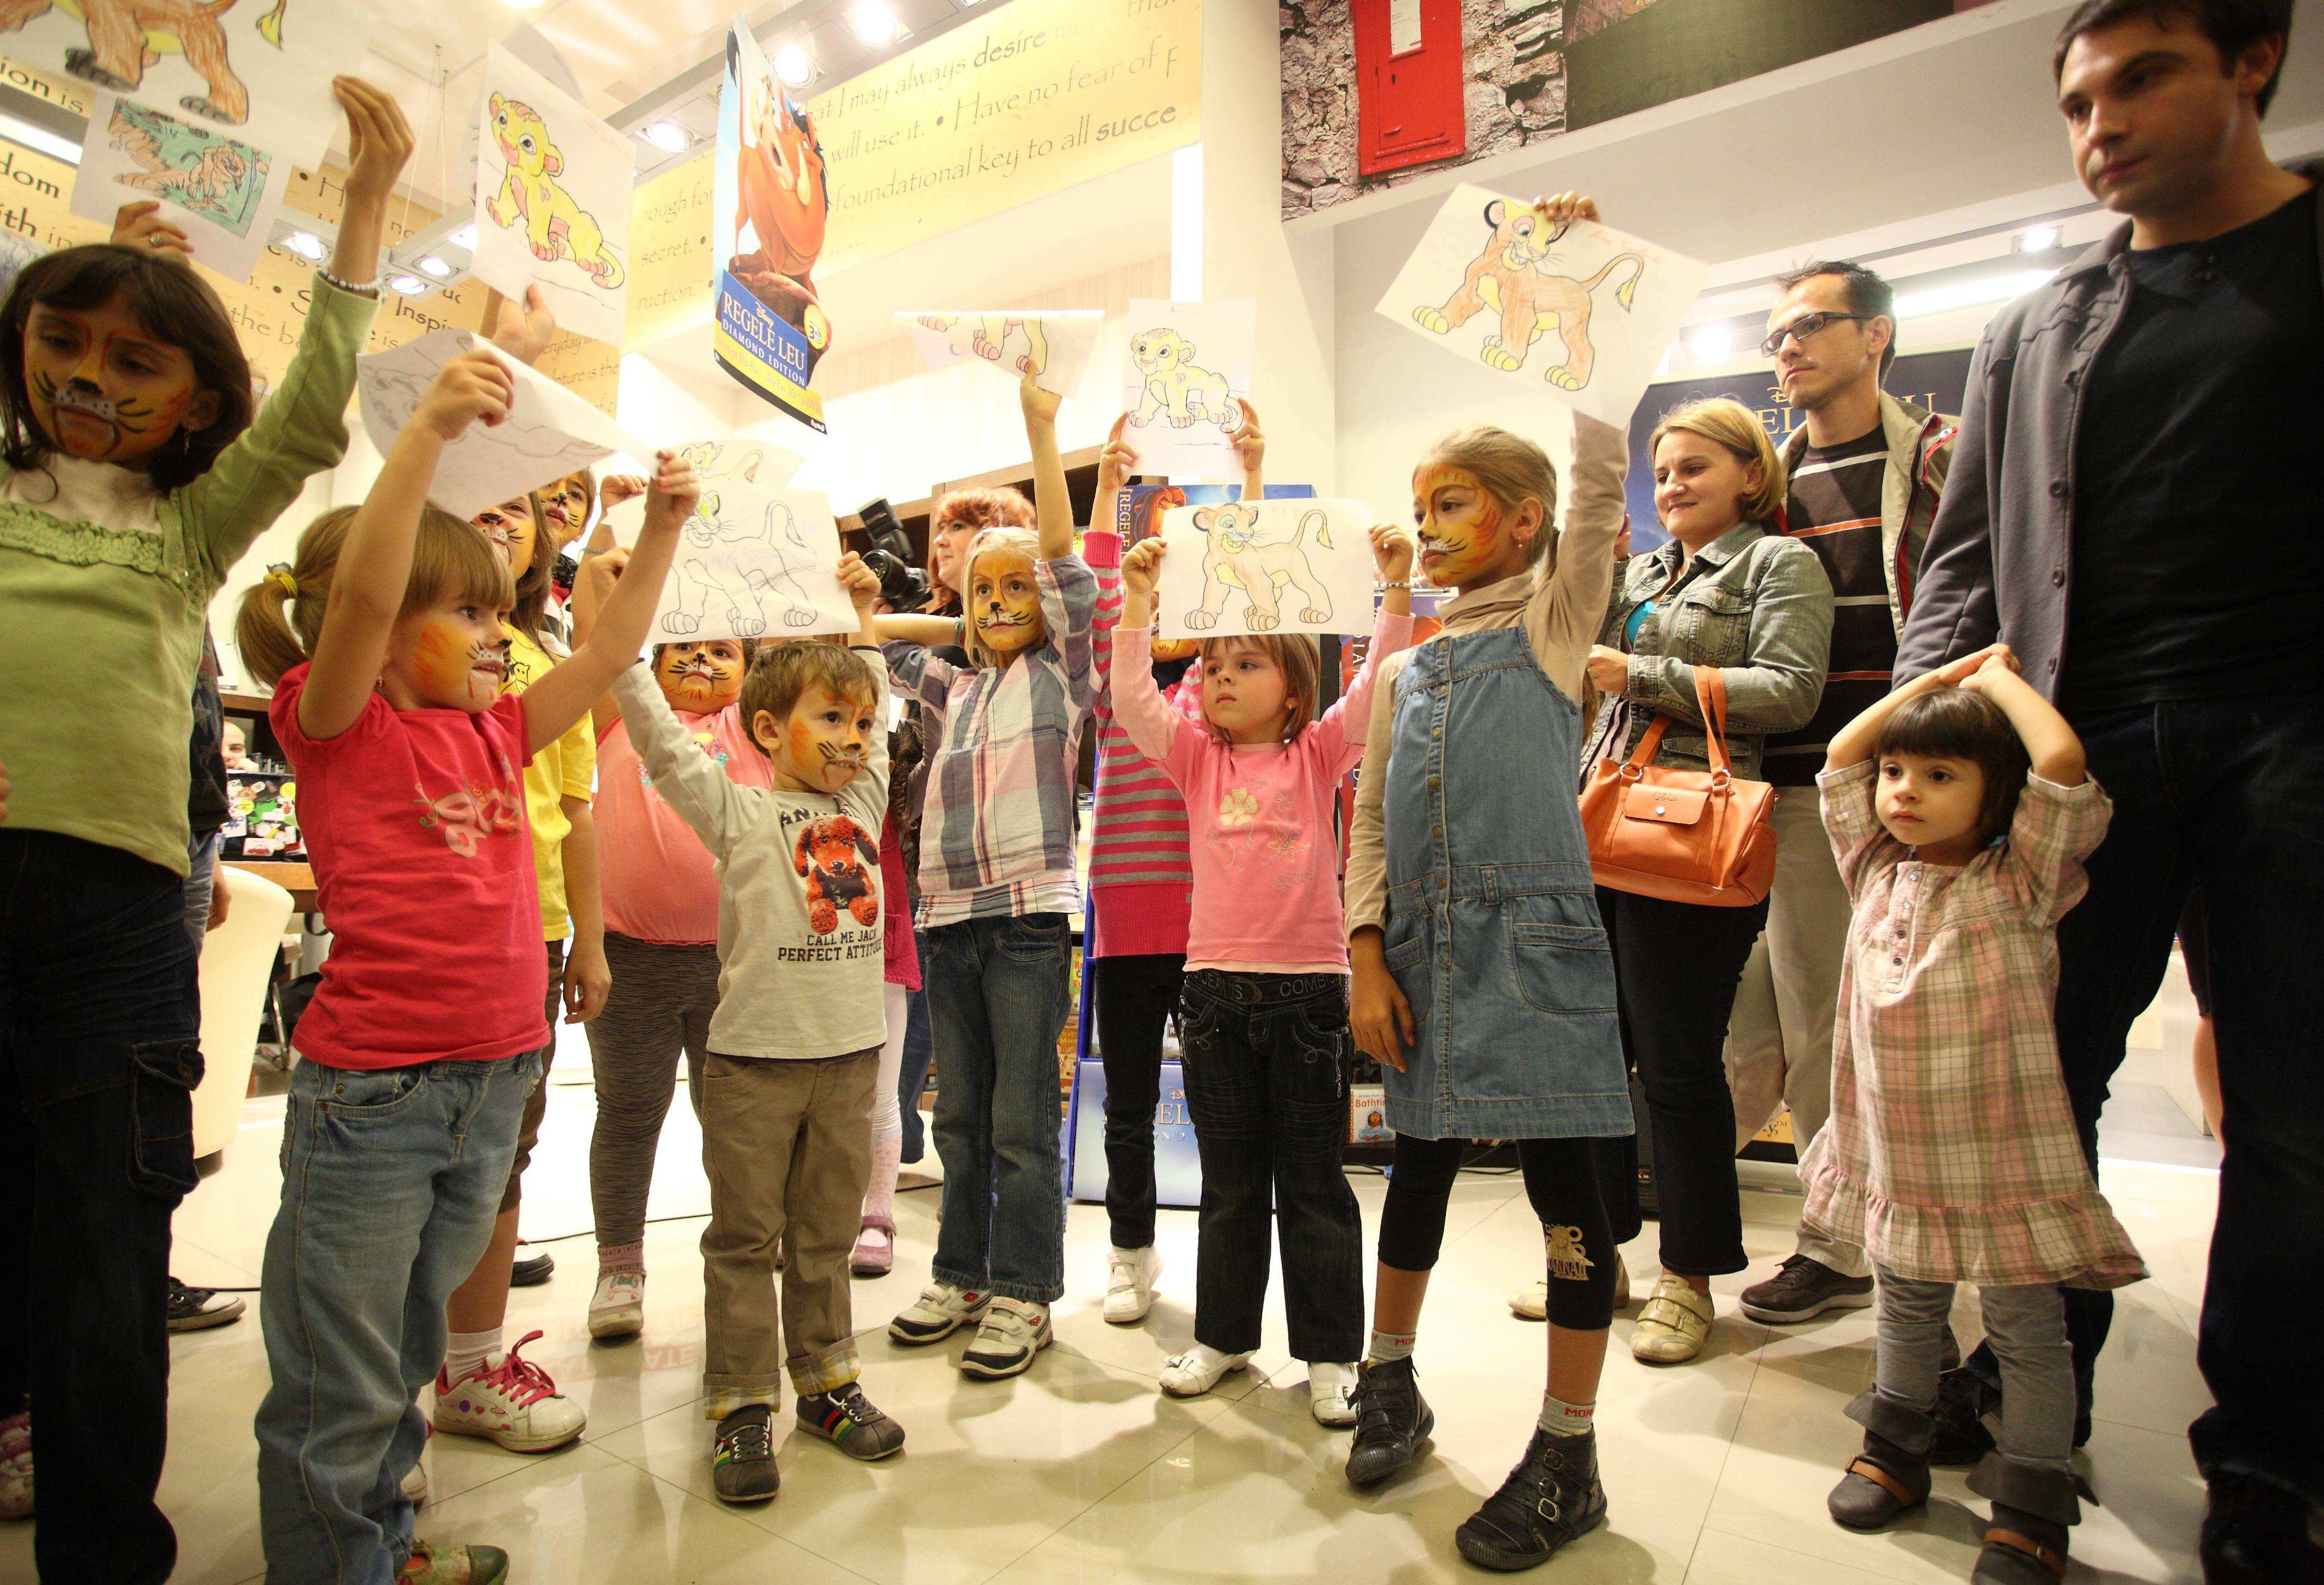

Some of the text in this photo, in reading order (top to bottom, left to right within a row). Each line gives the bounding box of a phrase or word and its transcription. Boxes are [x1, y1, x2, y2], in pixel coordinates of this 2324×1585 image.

[831, 129, 861, 162] will
[865, 132, 900, 153] use
[955, 92, 1019, 131] Have
[1028, 83, 1058, 103] no
[1067, 60, 1122, 92] fear
[1128, 35, 1162, 74] of
[850, 86, 889, 111] may
[895, 62, 966, 90] always
[973, 30, 1046, 67] desire
[836, 106, 1176, 211] foundational key to all succe
[723, 291, 776, 351] REGELE
[778, 336, 805, 370] LEU
[723, 319, 765, 358] DIAMOND
[768, 354, 805, 386] EDITION
[778, 946, 842, 961] PERFECT
[807, 933, 837, 946] CALL
[841, 931, 854, 944] ME
